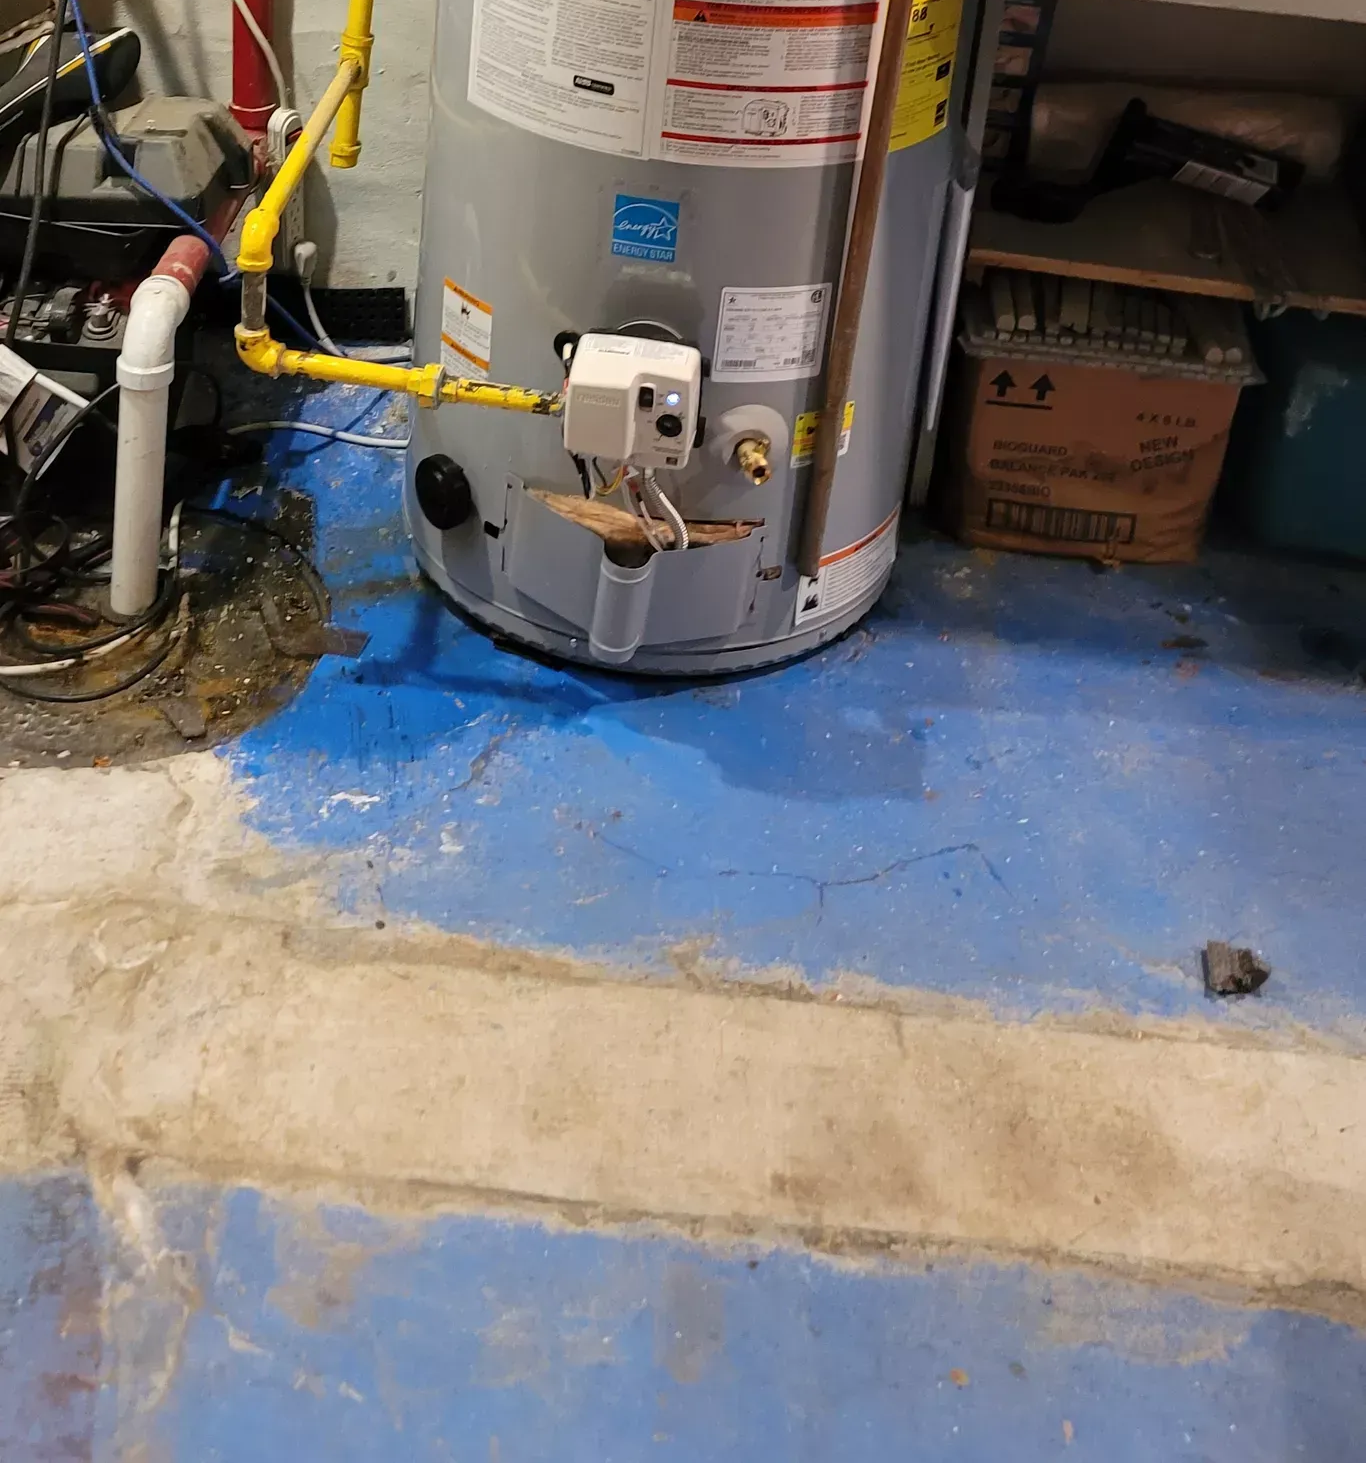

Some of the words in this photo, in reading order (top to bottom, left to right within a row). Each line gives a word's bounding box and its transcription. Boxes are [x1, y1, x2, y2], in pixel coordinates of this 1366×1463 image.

[613, 242, 648, 258] ENERGY
[650, 249, 673, 261] STAR
[1139, 436, 1179, 454] NEW
[1130, 449, 1195, 473] DESIGN
